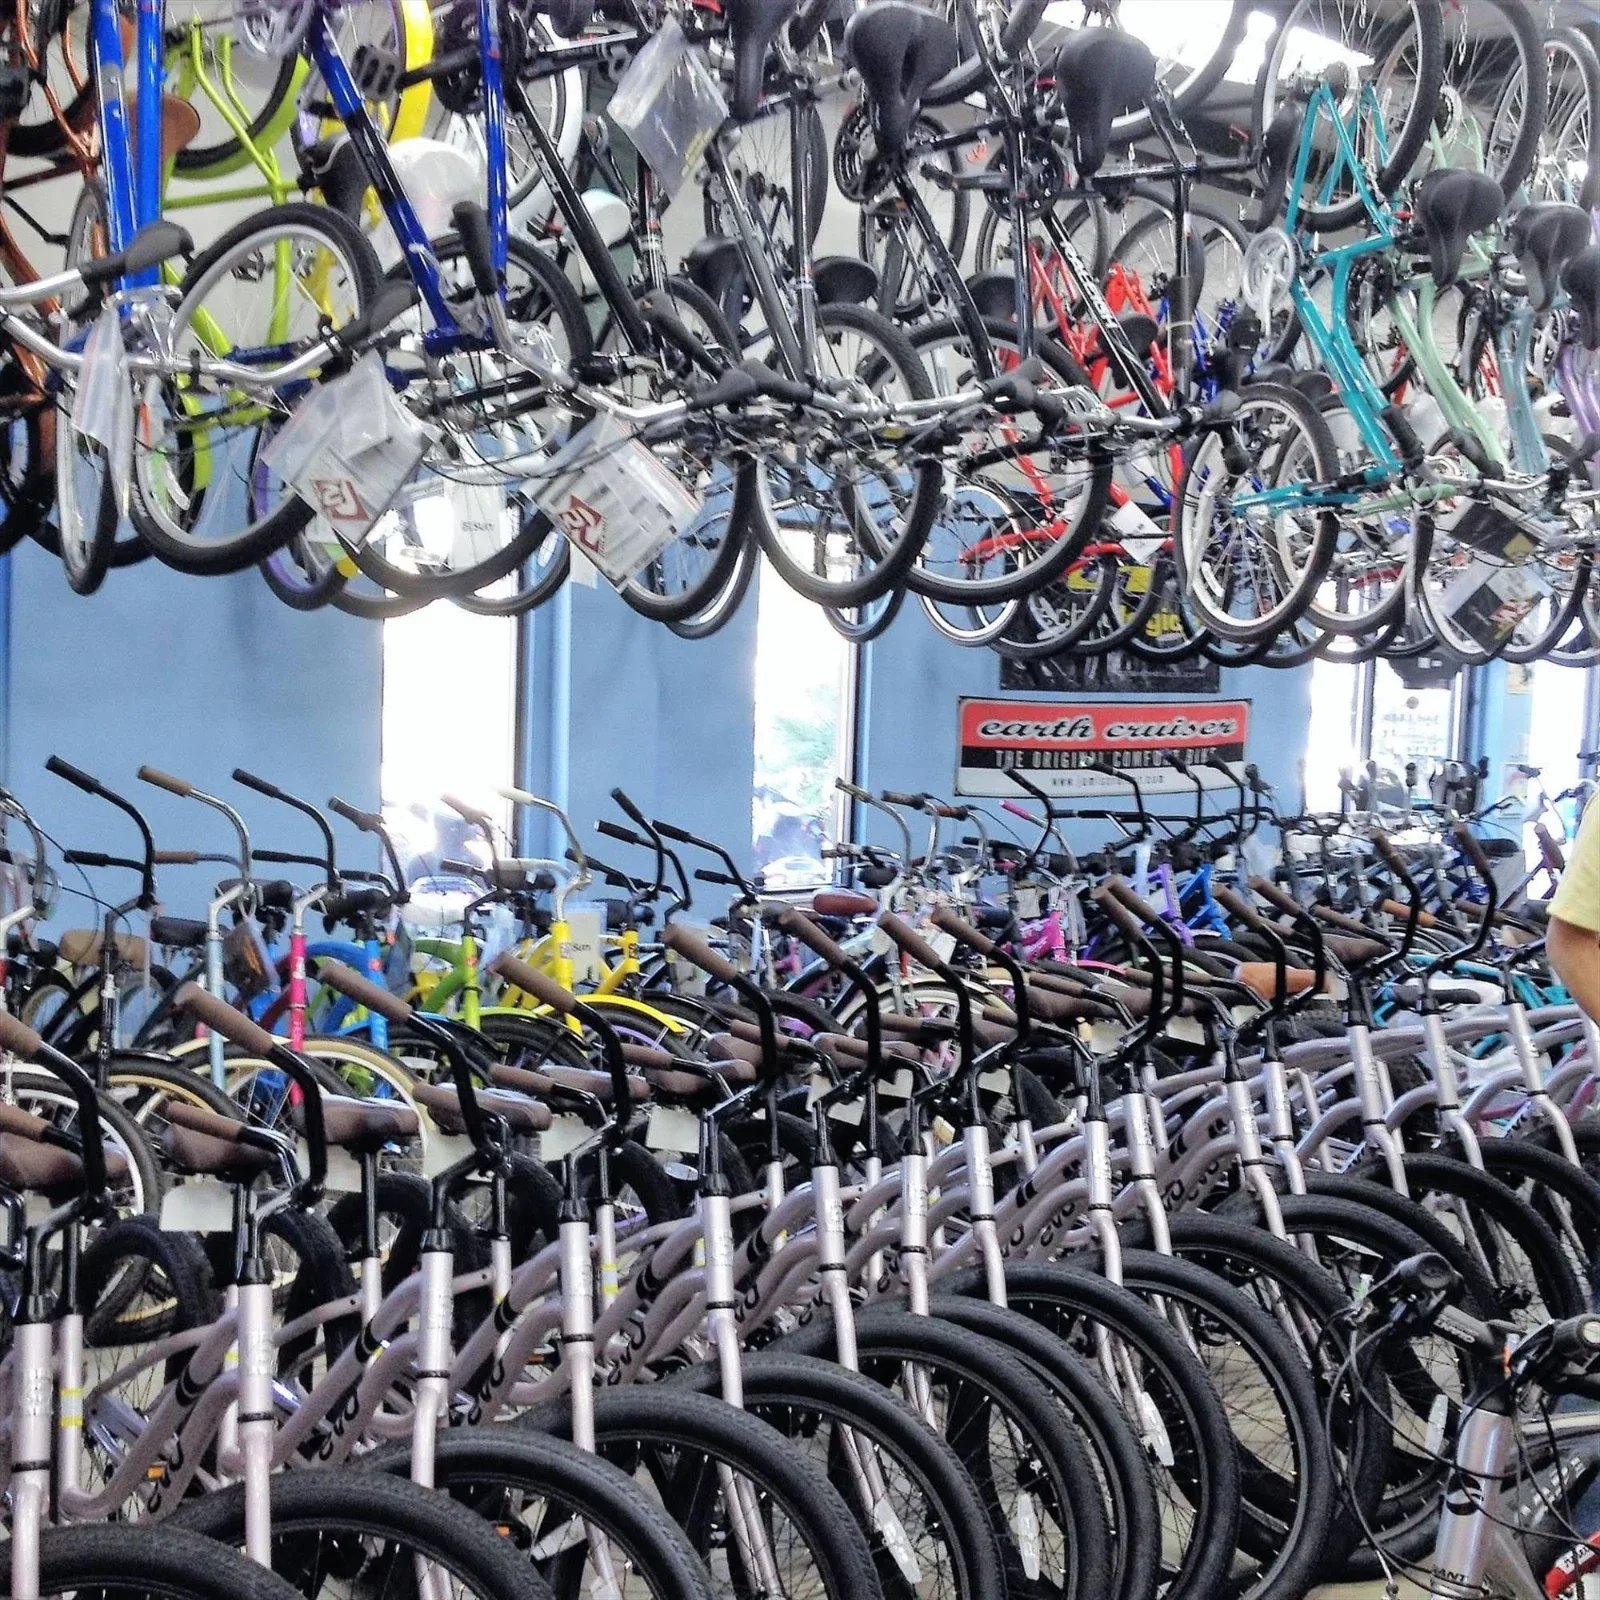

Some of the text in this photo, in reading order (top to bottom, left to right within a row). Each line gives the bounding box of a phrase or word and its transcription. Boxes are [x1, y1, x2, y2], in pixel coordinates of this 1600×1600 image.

[1060, 240, 1118, 328] RALEIGH
[980, 715, 1236, 739] earth cruiser
[995, 750, 1024, 769] THE
[1112, 749, 1180, 767] COMFOT
[1185, 747, 1217, 765] BIK
[1040, 1202, 1075, 1247] evo
